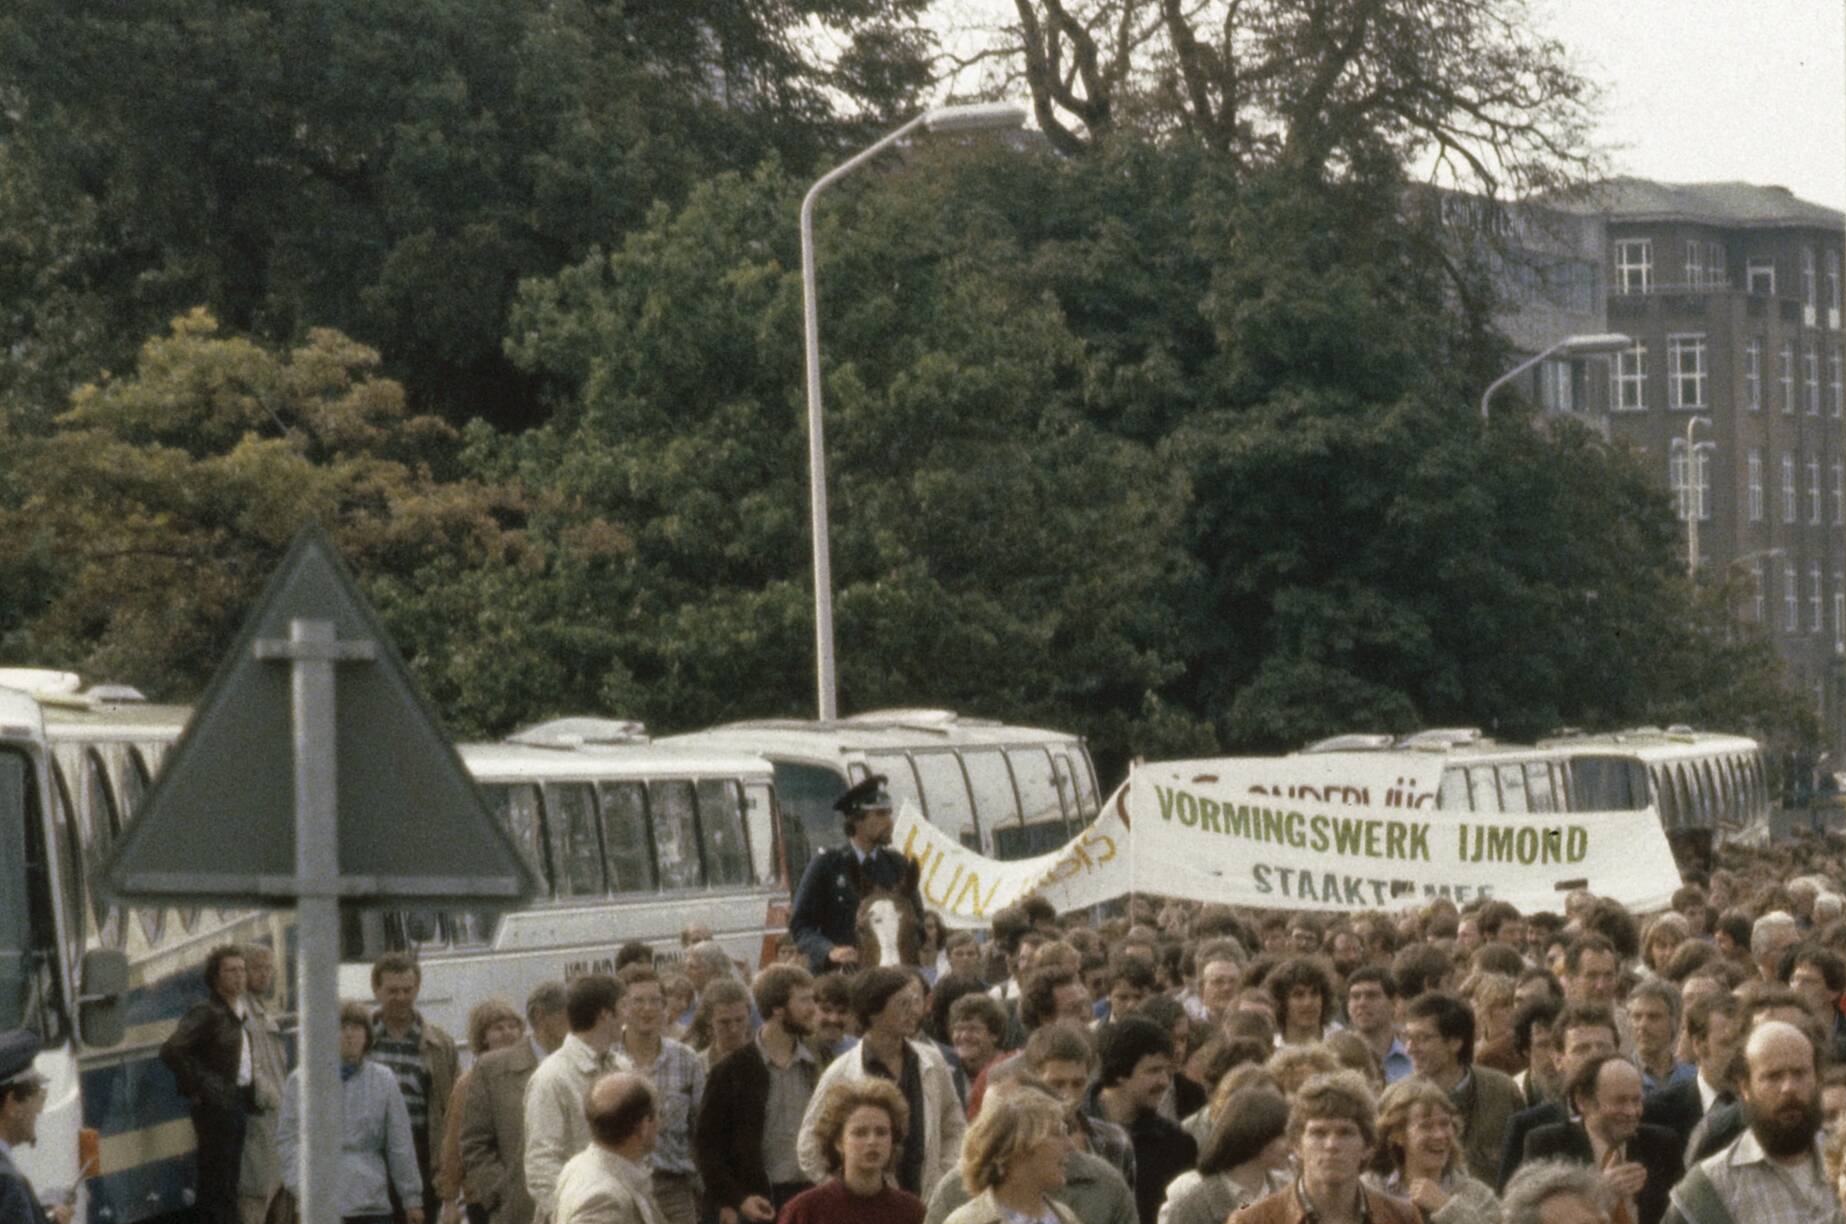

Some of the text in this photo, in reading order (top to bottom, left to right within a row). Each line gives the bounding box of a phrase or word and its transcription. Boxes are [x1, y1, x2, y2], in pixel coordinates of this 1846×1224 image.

[1154, 784, 1588, 865] VORMINGSWERK IJMOND
[1252, 862, 1388, 906] STAAKT
